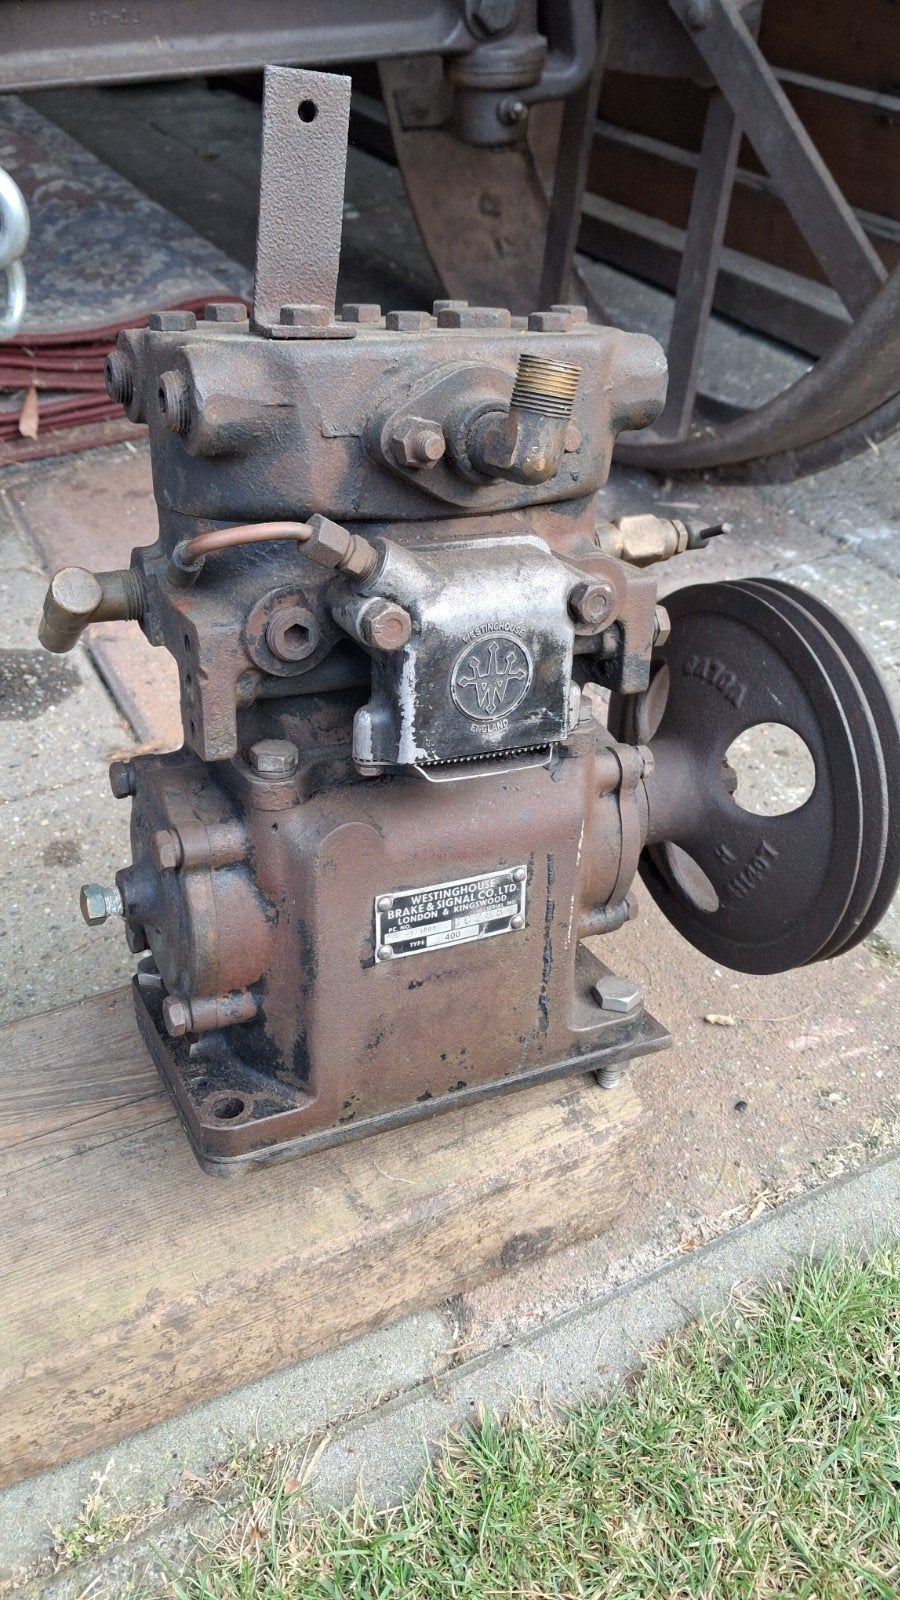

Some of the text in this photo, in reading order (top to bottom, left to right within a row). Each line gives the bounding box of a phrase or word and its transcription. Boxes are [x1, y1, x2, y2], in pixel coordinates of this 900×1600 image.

[462, 622, 527, 643] WESTINGHOUSE
[470, 719, 508, 733] ENGLAND
[387, 882, 518, 920] BRAKE & SIGNAL CO. LTD.
[411, 879, 495, 905] WESTINGHOUSE
[397, 909, 437, 925] LONDON
[443, 907, 448, 915] &
[453, 894, 506, 912] KINGSWOOD
[410, 939, 424, 947] TYPE
[445, 930, 460, 940] 400
